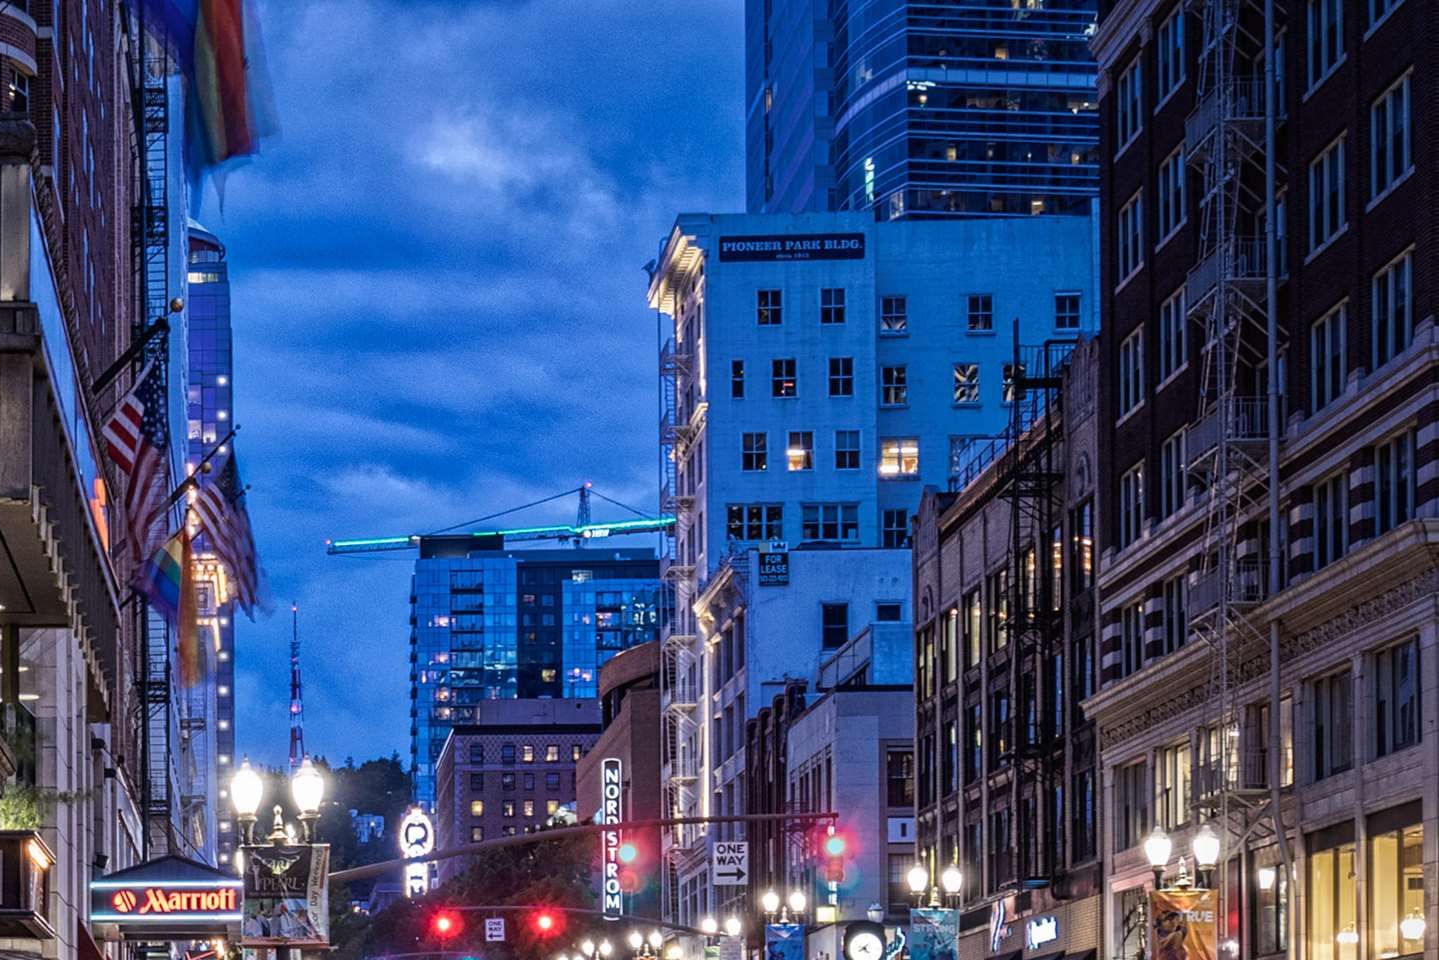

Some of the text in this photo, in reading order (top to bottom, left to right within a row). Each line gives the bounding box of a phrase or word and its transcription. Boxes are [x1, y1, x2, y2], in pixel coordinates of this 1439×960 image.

[722, 239, 863, 252] PIONEER PARK BLDG.
[765, 554, 782, 564] FOR
[760, 564, 787, 574] LEASE
[716, 844, 745, 854] ONE
[716, 855, 745, 866] WAY
[138, 887, 237, 914] Marriott
[310, 890, 320, 906] Day
[1177, 910, 1214, 923] TRUE
[913, 923, 955, 934] STRONG
